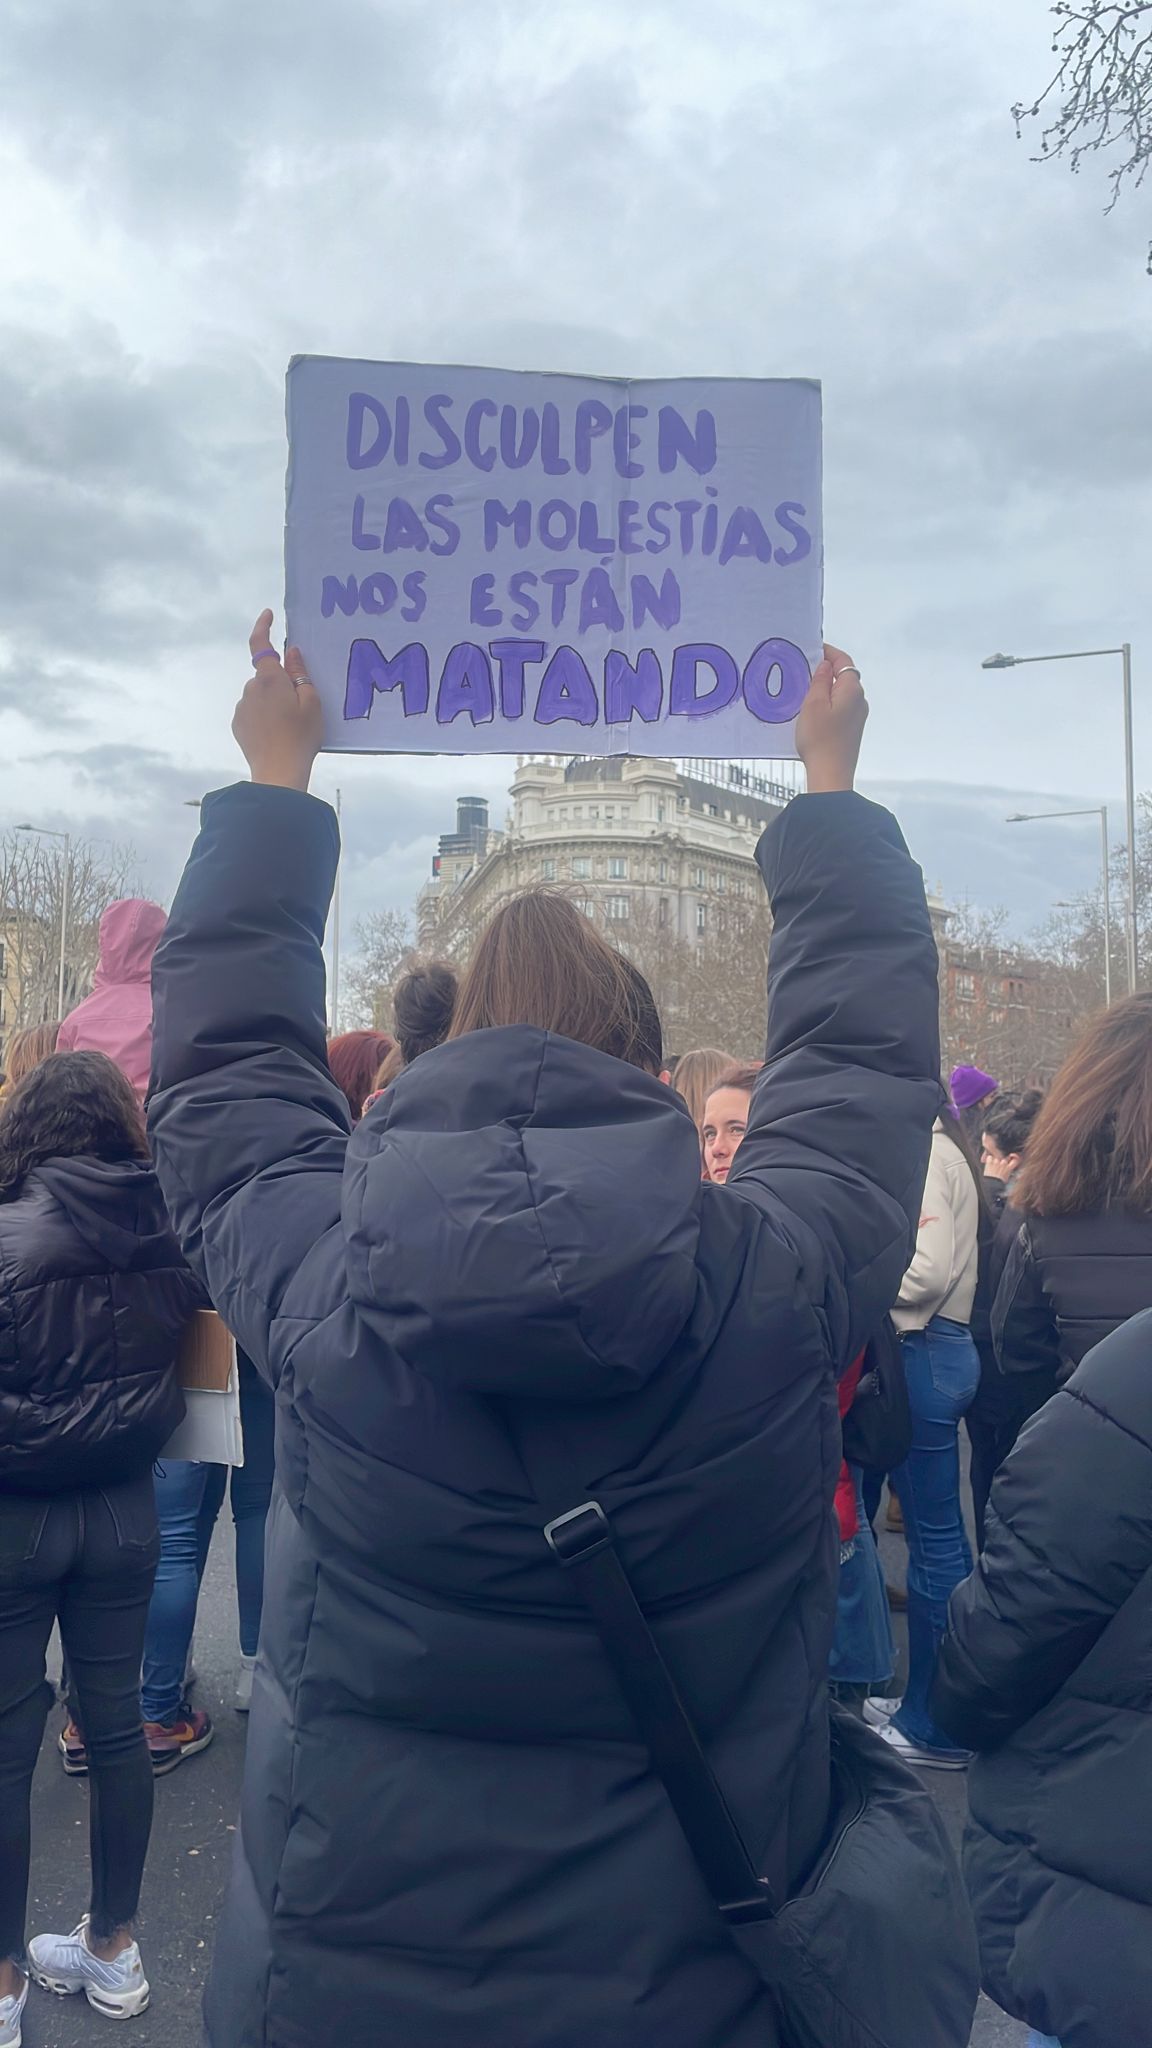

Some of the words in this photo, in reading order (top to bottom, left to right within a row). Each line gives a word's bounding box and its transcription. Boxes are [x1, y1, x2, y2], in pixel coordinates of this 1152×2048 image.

[347, 392, 717, 478] DISCULPEN
[352, 494, 461, 556] LAS
[321, 570, 427, 622] NOS
[470, 556, 681, 635] ESTÁN
[343, 637, 812, 727] MATANDO
